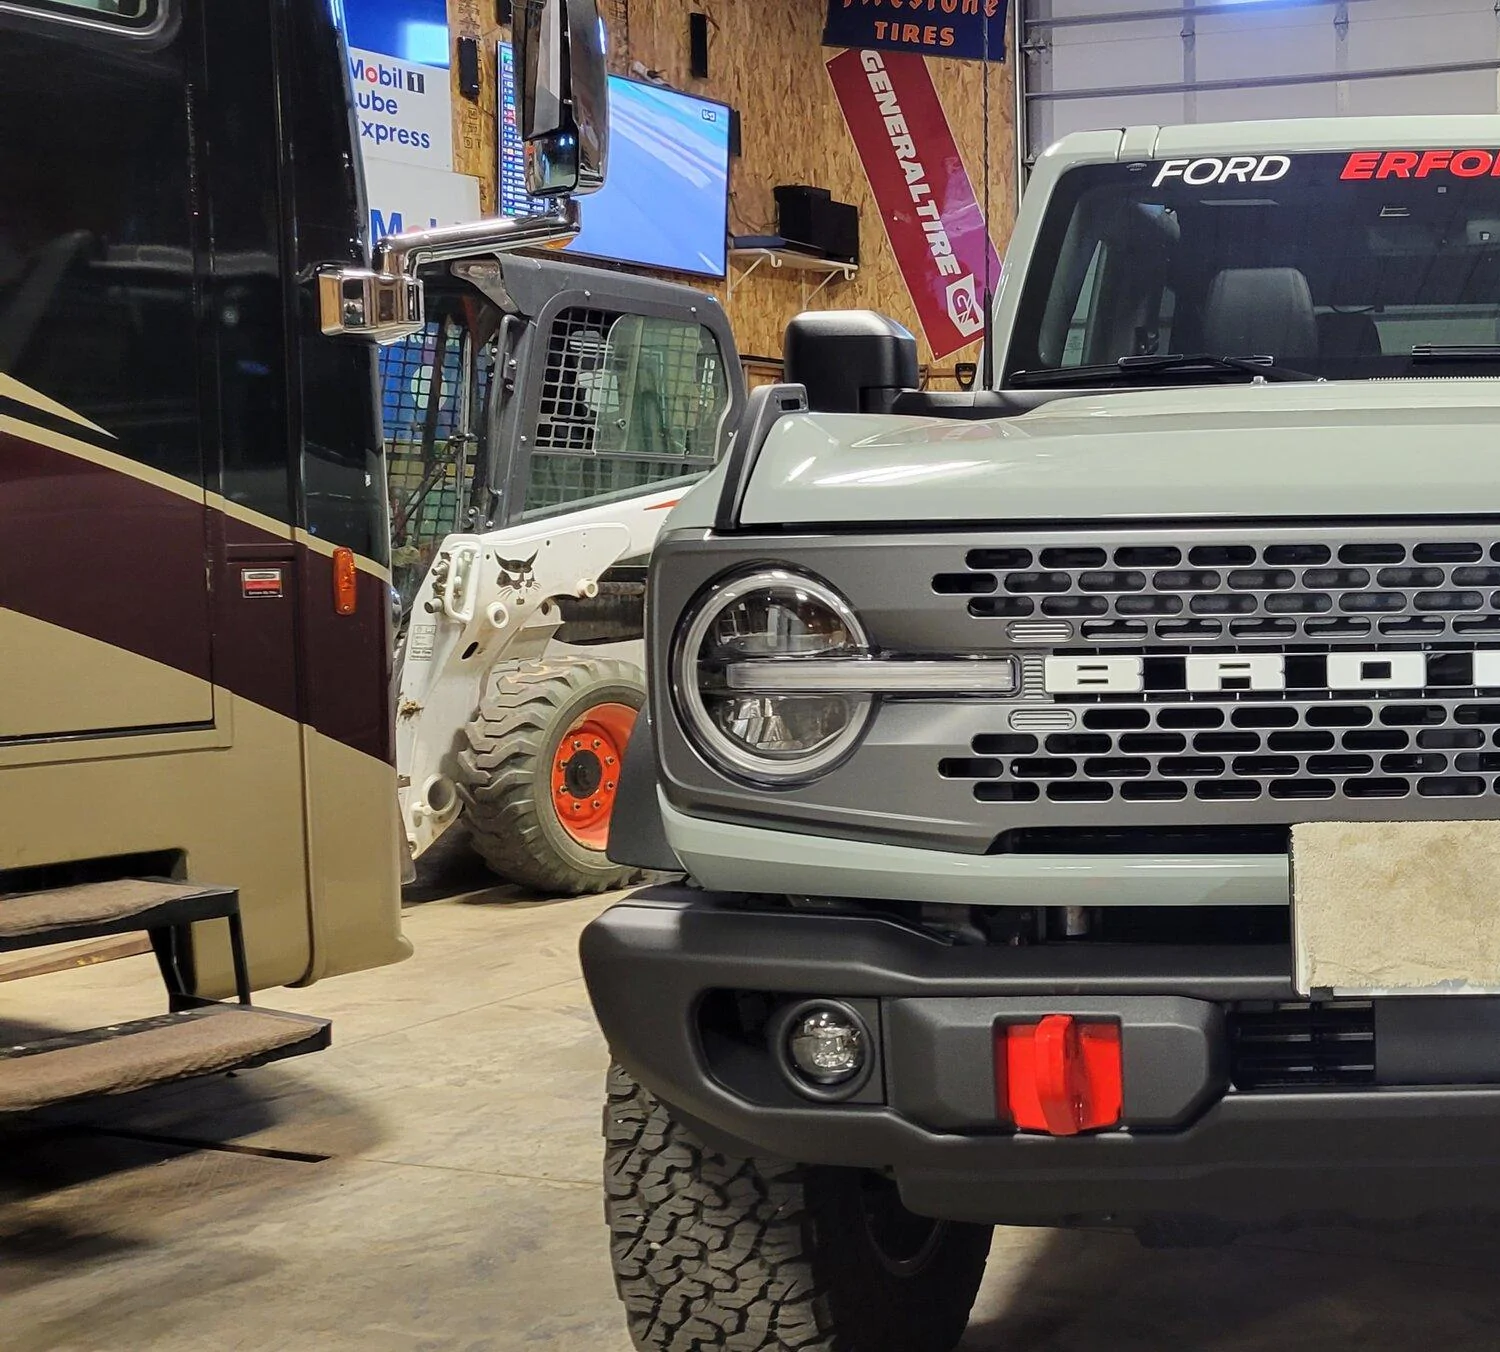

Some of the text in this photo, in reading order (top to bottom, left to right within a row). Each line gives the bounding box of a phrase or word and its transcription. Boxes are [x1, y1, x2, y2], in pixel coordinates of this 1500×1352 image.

[874, 21, 955, 46] TIRES
[350, 57, 403, 89] Mobil
[355, 90, 399, 115] ube
[356, 117, 431, 149] xpress
[1152, 155, 1291, 188] FORD
